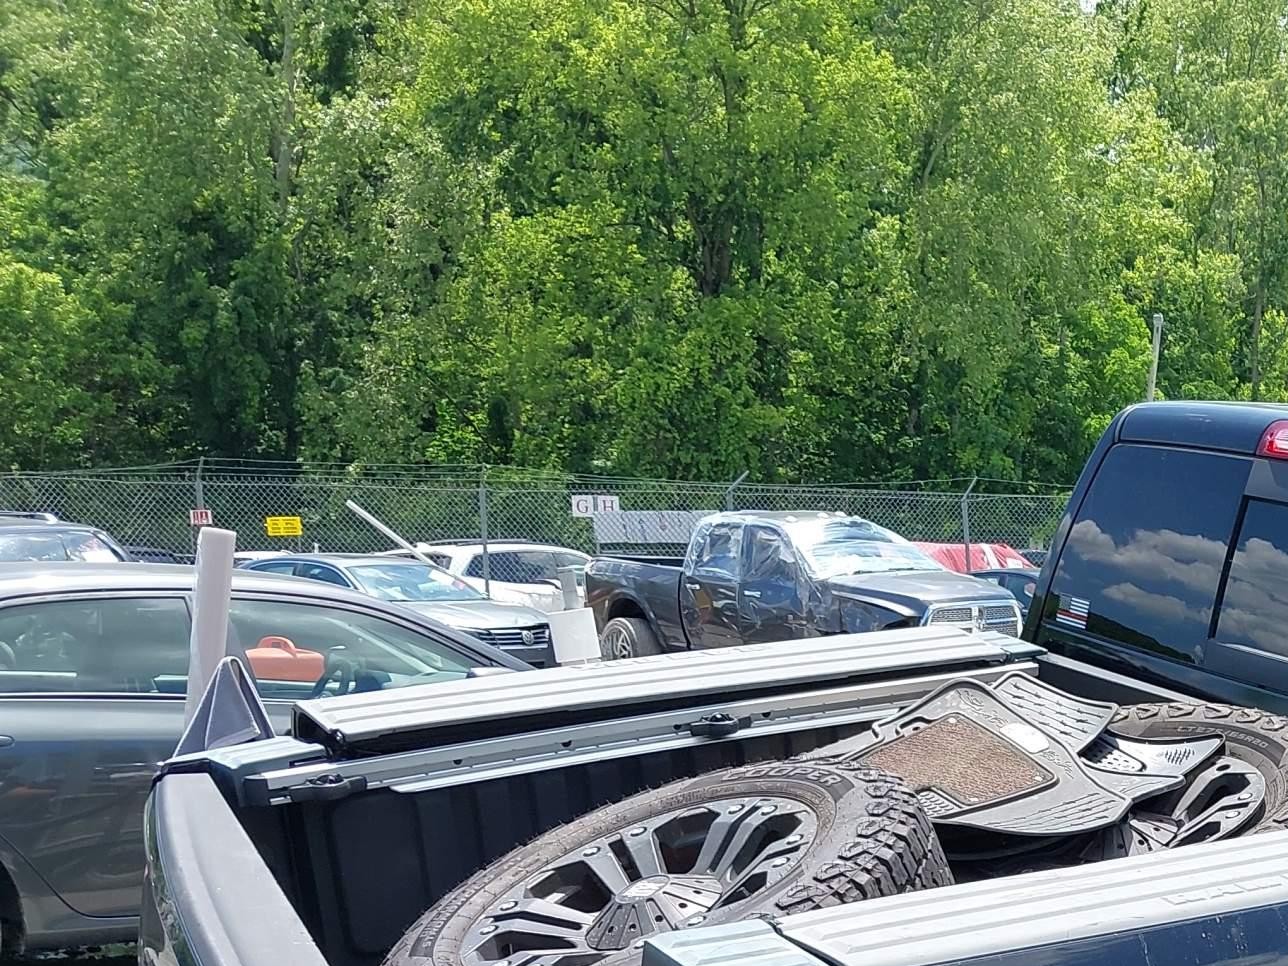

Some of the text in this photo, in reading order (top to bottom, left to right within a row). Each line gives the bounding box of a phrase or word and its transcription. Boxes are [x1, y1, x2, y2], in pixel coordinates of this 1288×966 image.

[576, 499, 614, 513] G H
[720, 765, 842, 788] COOPER
